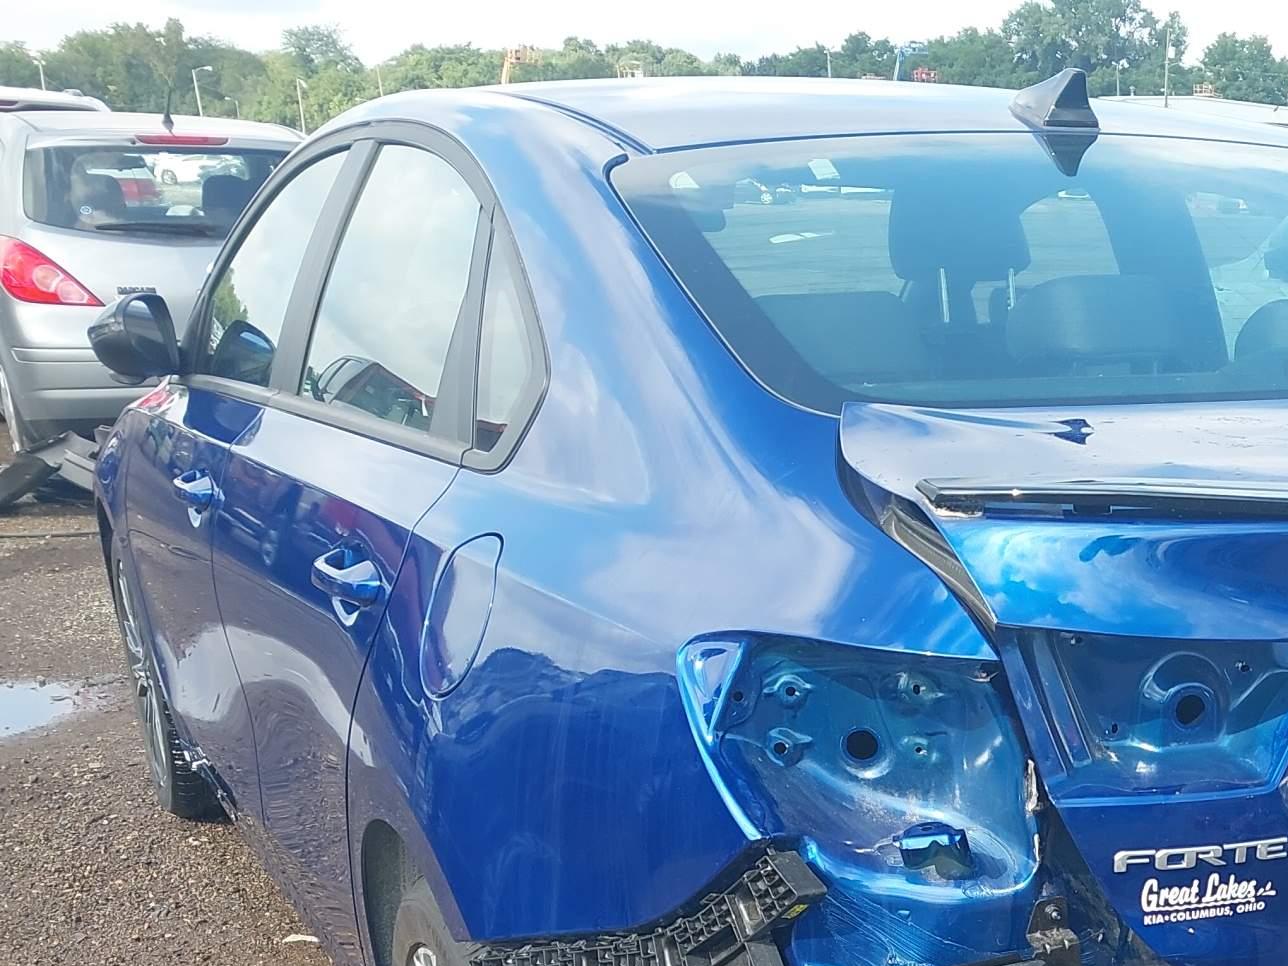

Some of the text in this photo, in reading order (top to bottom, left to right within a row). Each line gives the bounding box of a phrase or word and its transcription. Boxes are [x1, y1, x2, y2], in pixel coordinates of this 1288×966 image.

[1113, 836, 1288, 873] FORTE
[1141, 873, 1256, 912] Great Lakes
[1236, 901, 1265, 914] OHIO
